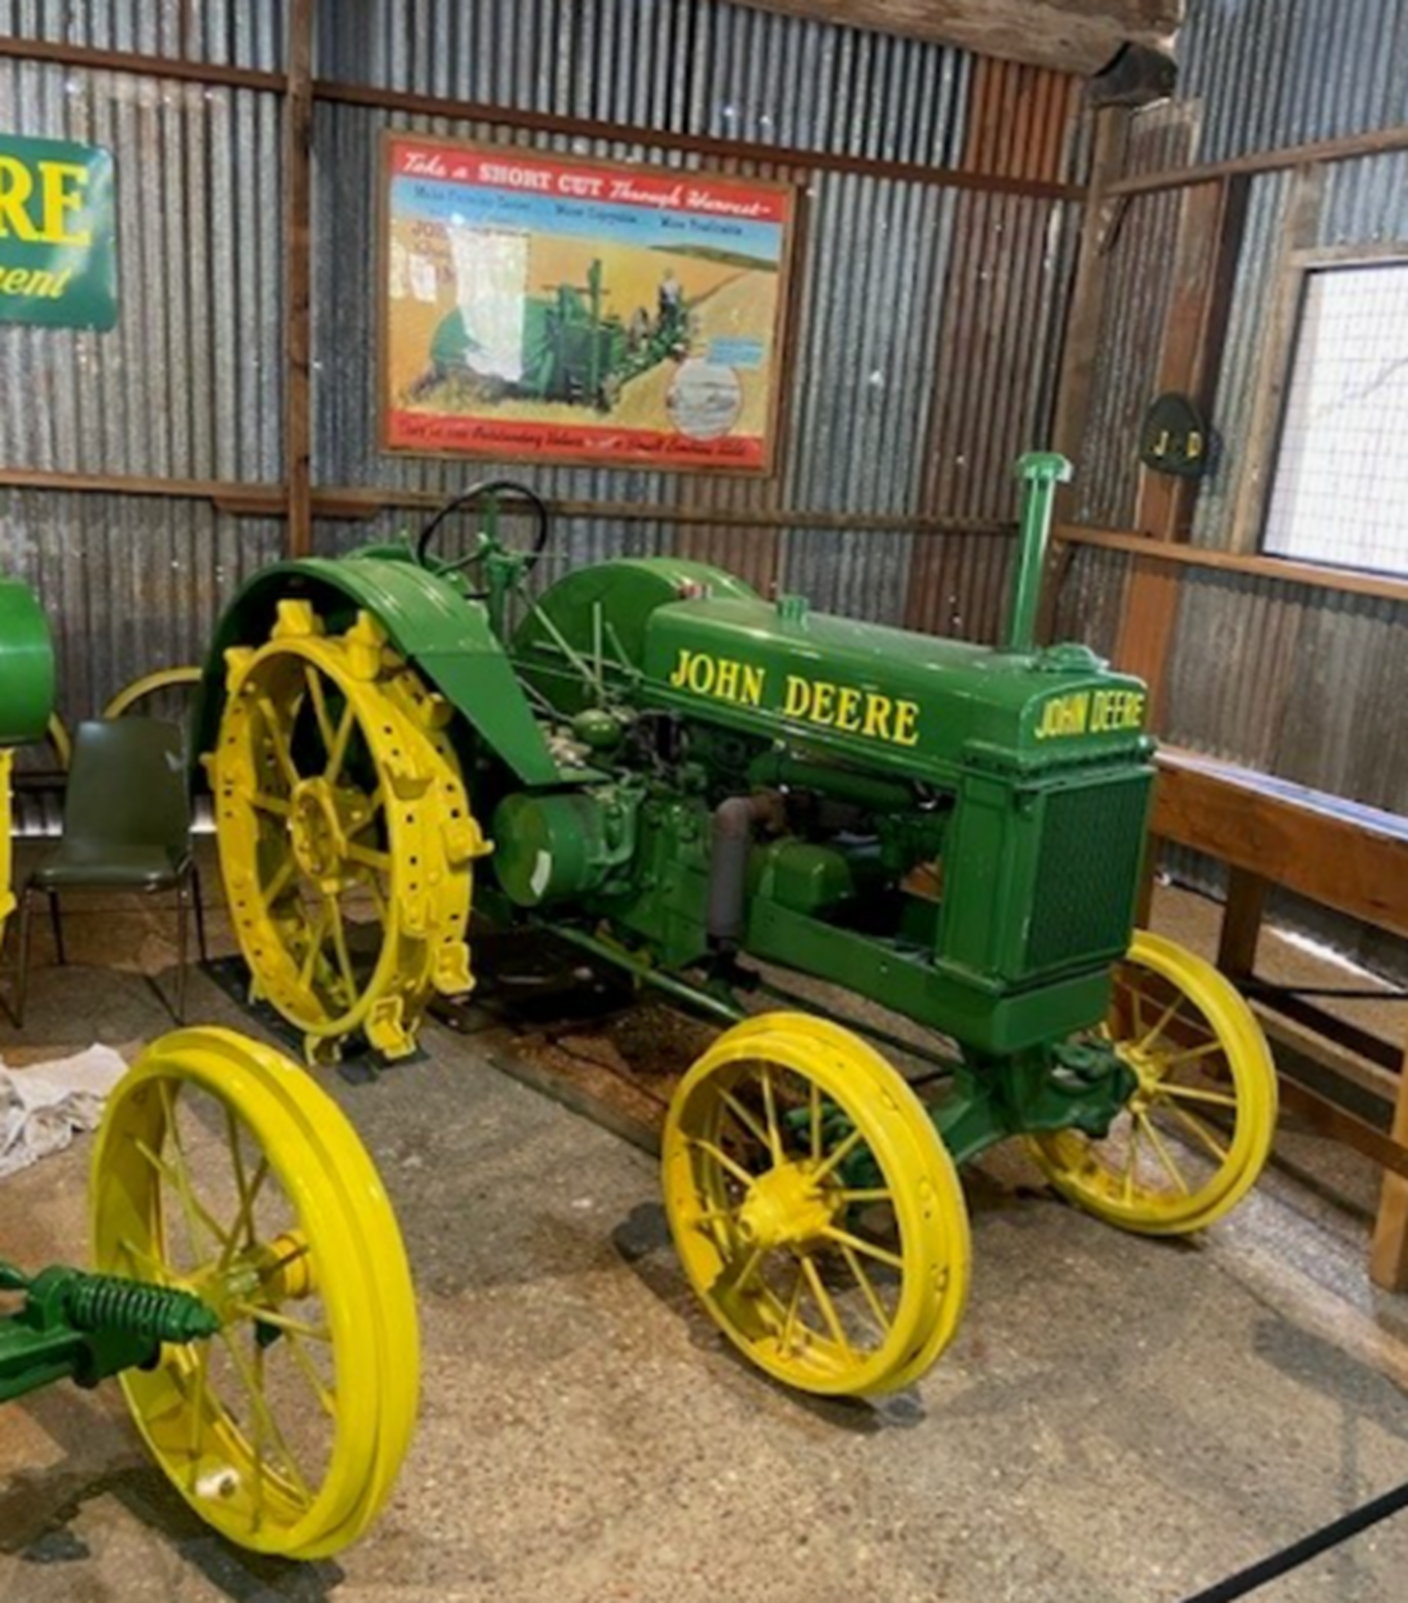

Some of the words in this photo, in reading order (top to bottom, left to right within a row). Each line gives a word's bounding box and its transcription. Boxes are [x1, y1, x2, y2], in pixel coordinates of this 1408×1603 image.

[403, 152, 446, 178] Take
[478, 162, 552, 190] SHORT
[557, 173, 604, 197] CUT
[610, 179, 682, 209] Through
[1154, 430, 1169, 456] J
[1187, 431, 1202, 458] D
[670, 650, 765, 706] JOHN
[784, 674, 920, 746] DEERE
[1034, 692, 1088, 739] JOHN
[1089, 689, 1144, 732] DEERE
